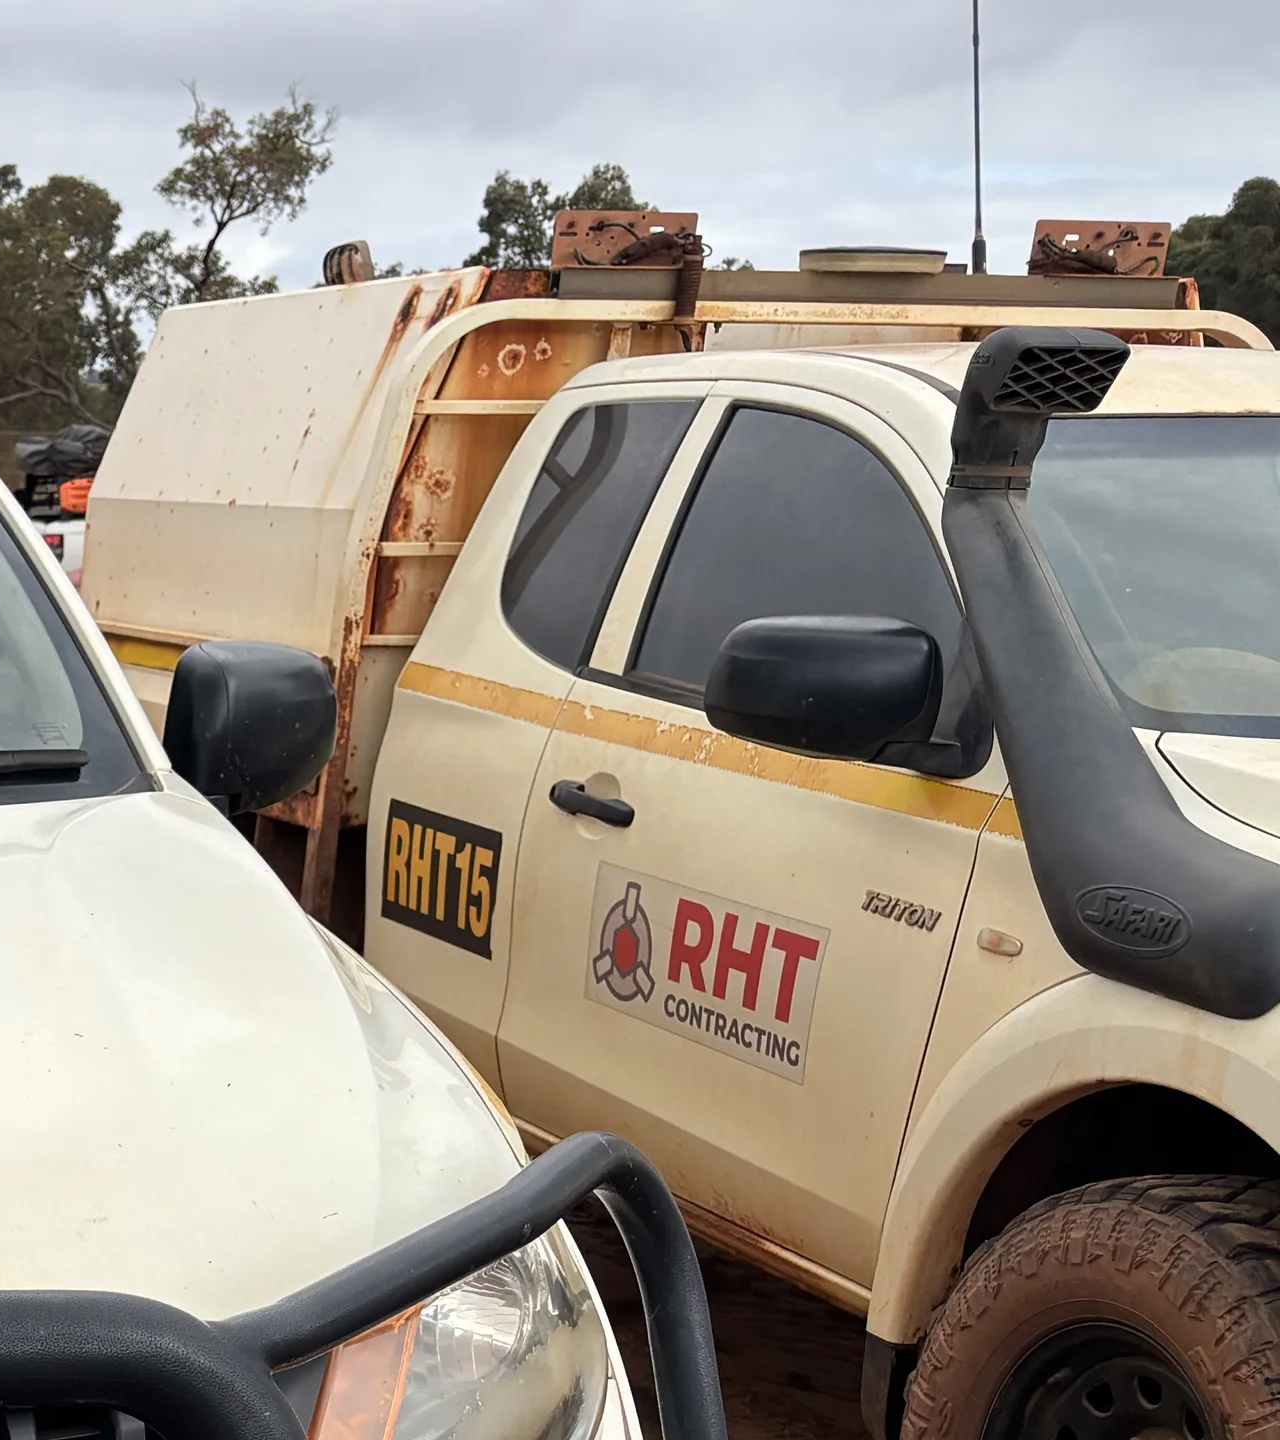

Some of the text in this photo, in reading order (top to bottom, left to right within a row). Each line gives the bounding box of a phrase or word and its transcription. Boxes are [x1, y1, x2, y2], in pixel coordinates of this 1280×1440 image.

[386, 817, 494, 938] RHT15
[861, 889, 942, 933] TRITON
[1083, 890, 1183, 945] SAFARI
[667, 897, 821, 1025] RHT
[663, 994, 801, 1067] CONTRACTING
